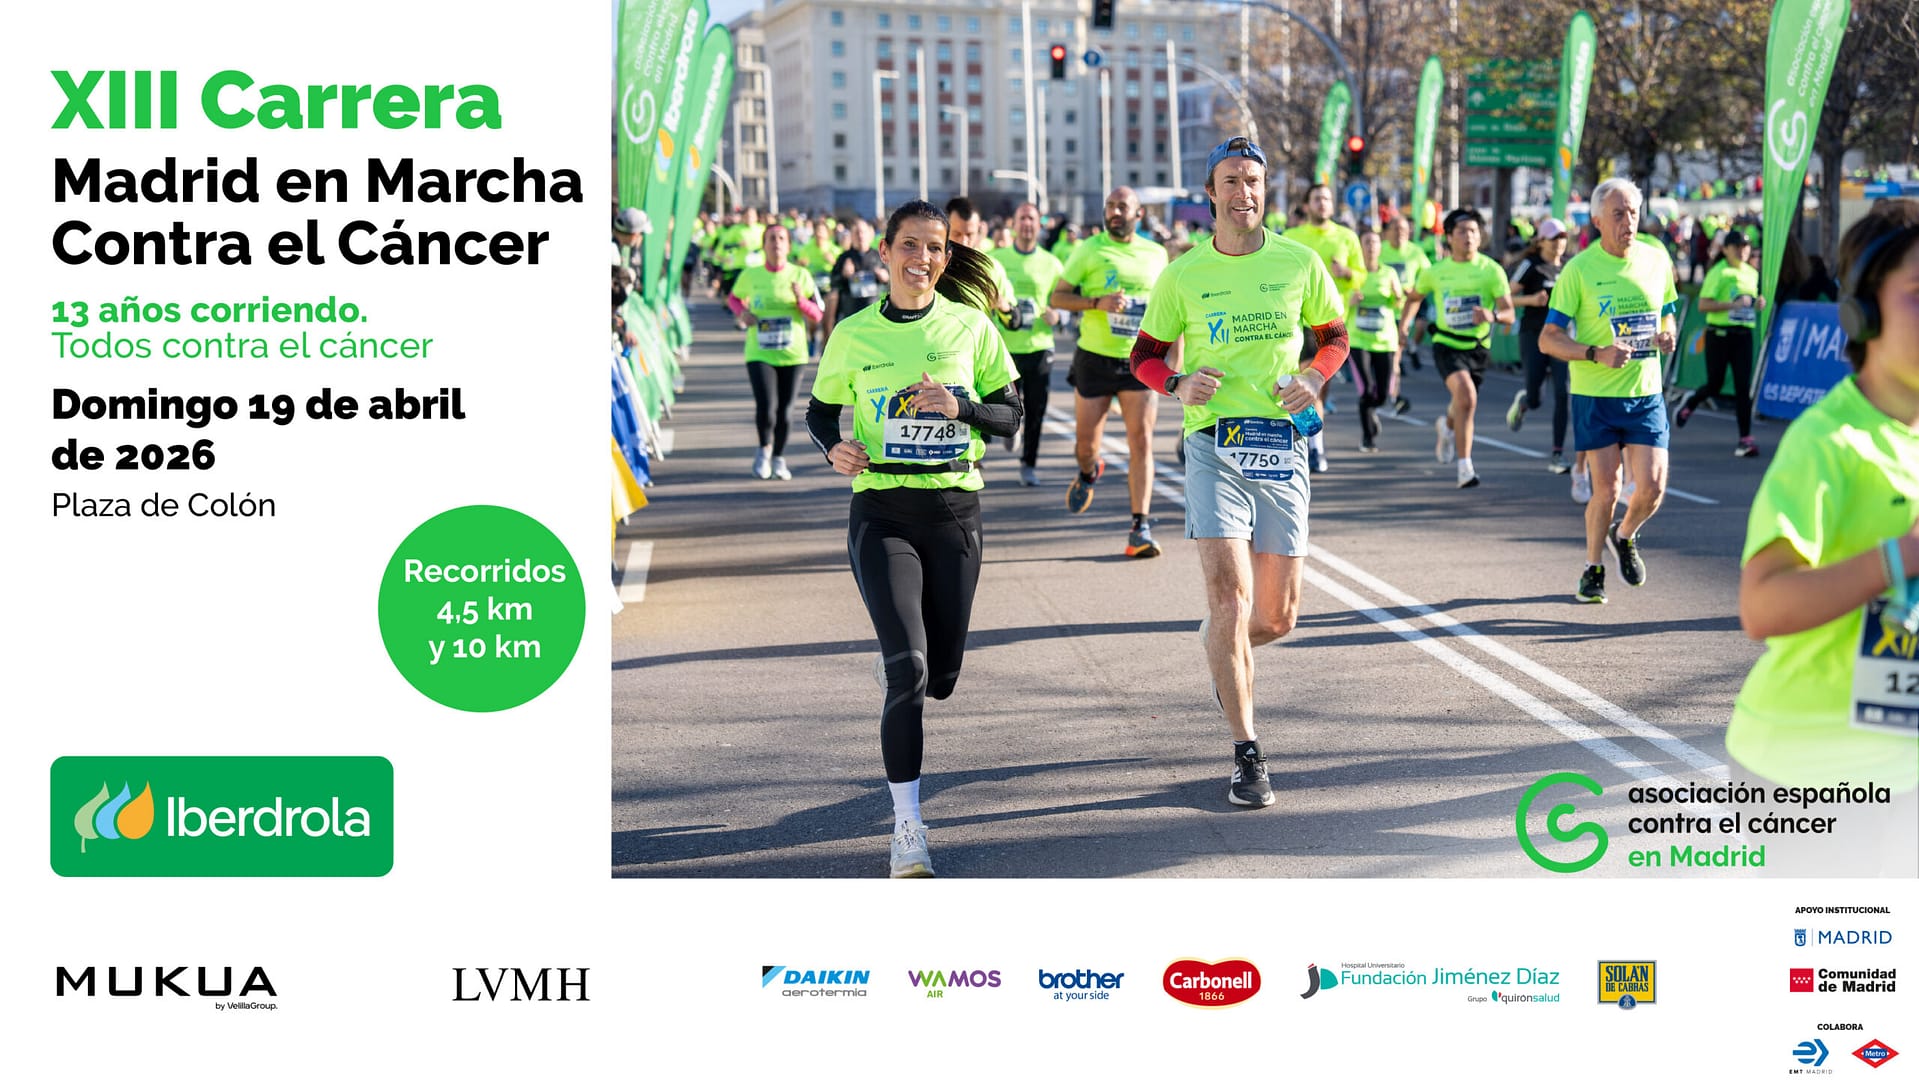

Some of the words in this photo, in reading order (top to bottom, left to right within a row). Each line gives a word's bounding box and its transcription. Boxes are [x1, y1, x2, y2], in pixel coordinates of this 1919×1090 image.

[1232, 312, 1272, 323] MADRID
[1274, 311, 1287, 320] EN
[1208, 318, 1229, 345] XII
[1233, 322, 1277, 333] MARCHA
[1234, 334, 1264, 342] CONTRA
[901, 424, 955, 441] 17748
[1223, 424, 1245, 446] XII
